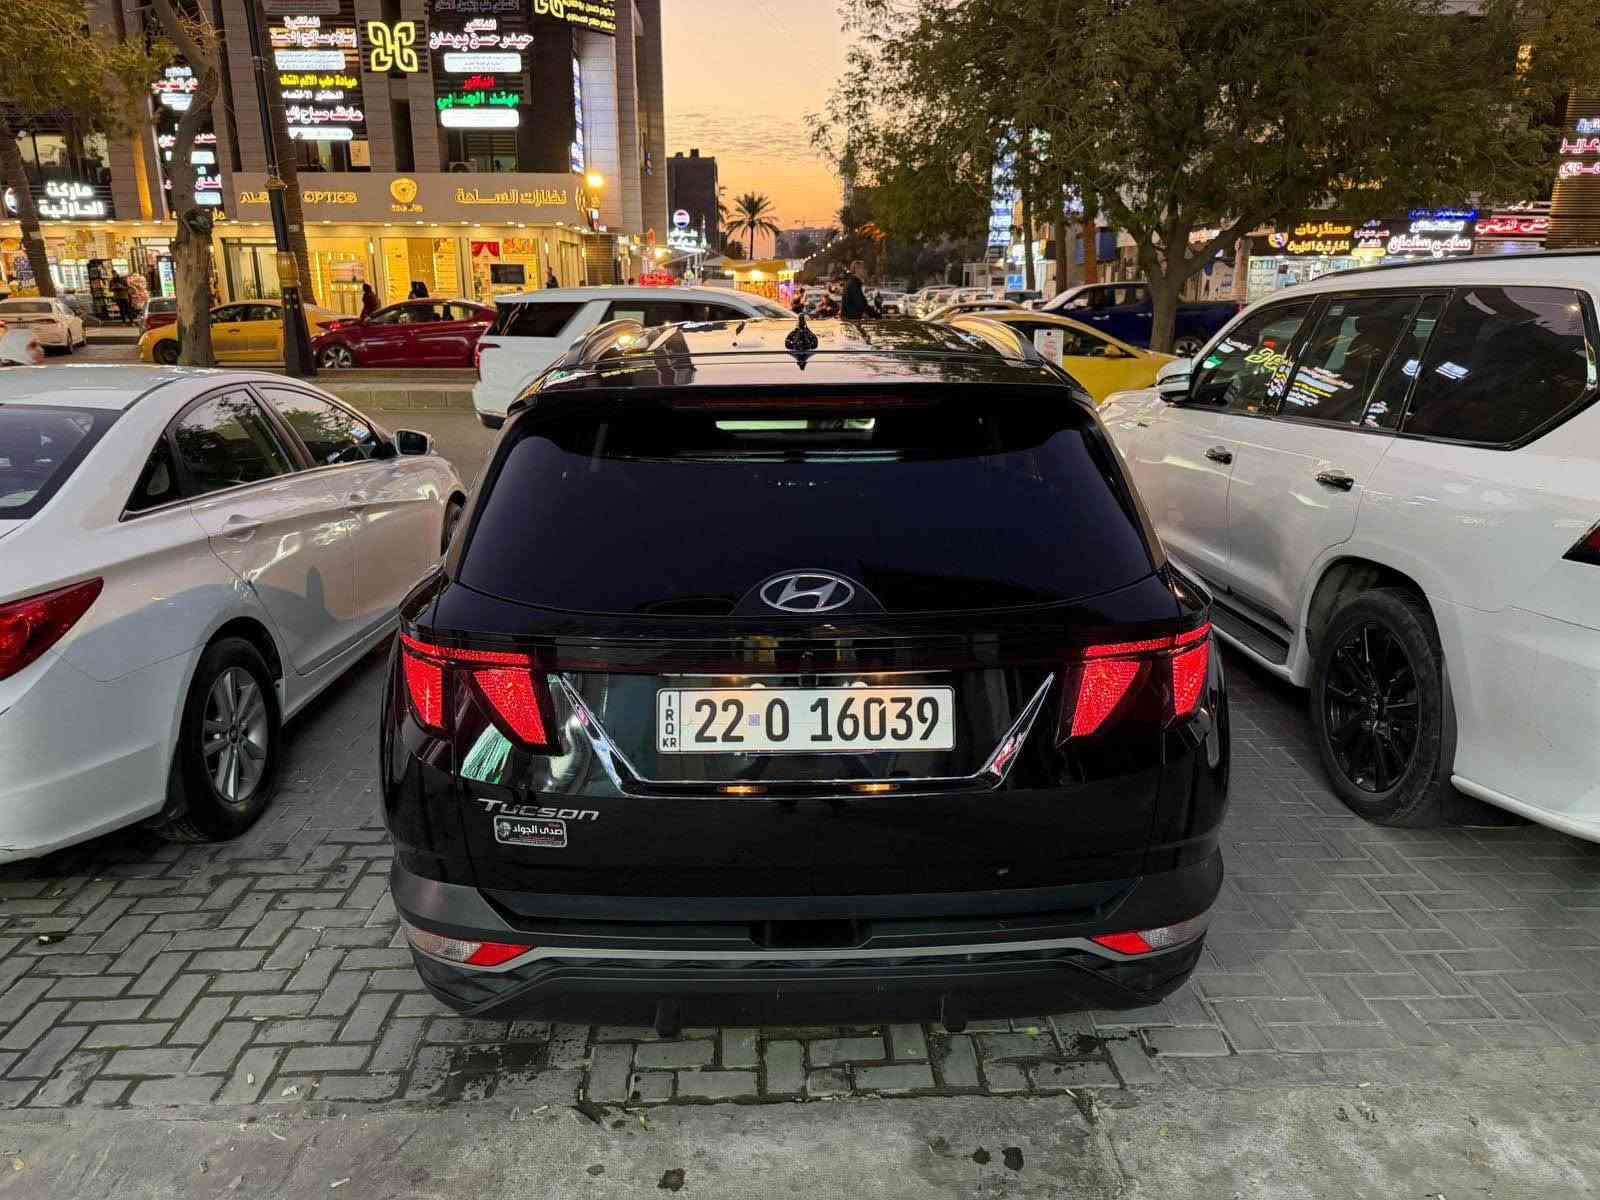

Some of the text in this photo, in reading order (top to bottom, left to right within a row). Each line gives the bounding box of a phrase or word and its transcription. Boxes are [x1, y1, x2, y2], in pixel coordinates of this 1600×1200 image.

[469, 33, 501, 49] حسن
[499, 32, 535, 50] حيدر
[520, 188, 568, 207] نظارات
[1294, 222, 1353, 237] مستلزمات
[694, 698, 744, 742] 22
[810, 696, 939, 742] 16039
[662, 737, 677, 748] KR
[511, 823, 538, 835] الجواد
